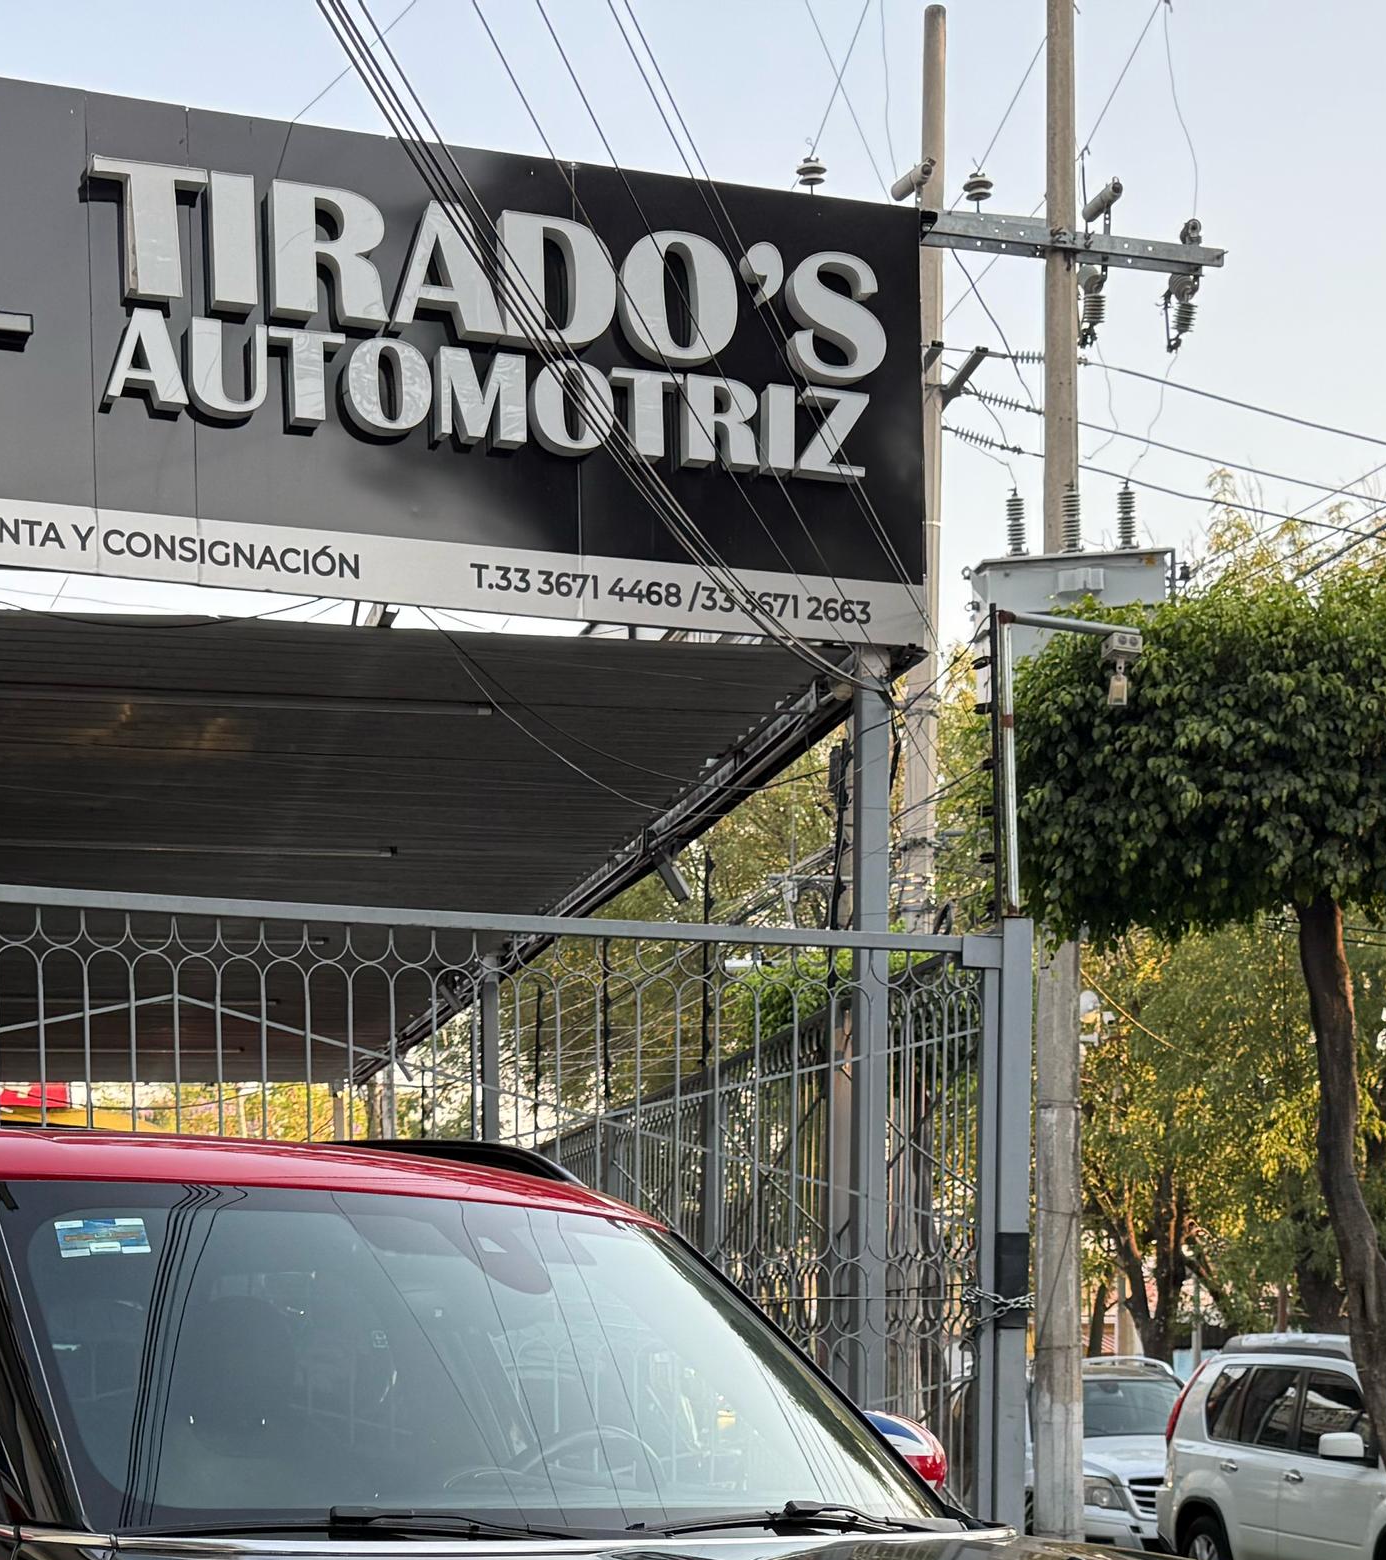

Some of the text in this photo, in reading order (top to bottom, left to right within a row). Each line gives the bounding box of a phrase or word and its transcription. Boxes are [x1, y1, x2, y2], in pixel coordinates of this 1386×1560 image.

[102, 308, 871, 484] AUTOMOTRIZ
[70, 524, 97, 553] Y
[102, 527, 362, 580] CONSIGNACIÓN
[469, 562, 531, 593] T.33
[536, 569, 599, 600] 3671
[606, 577, 683, 608] 4468
[687, 580, 736, 614] /33
[805, 596, 872, 625] 2663
